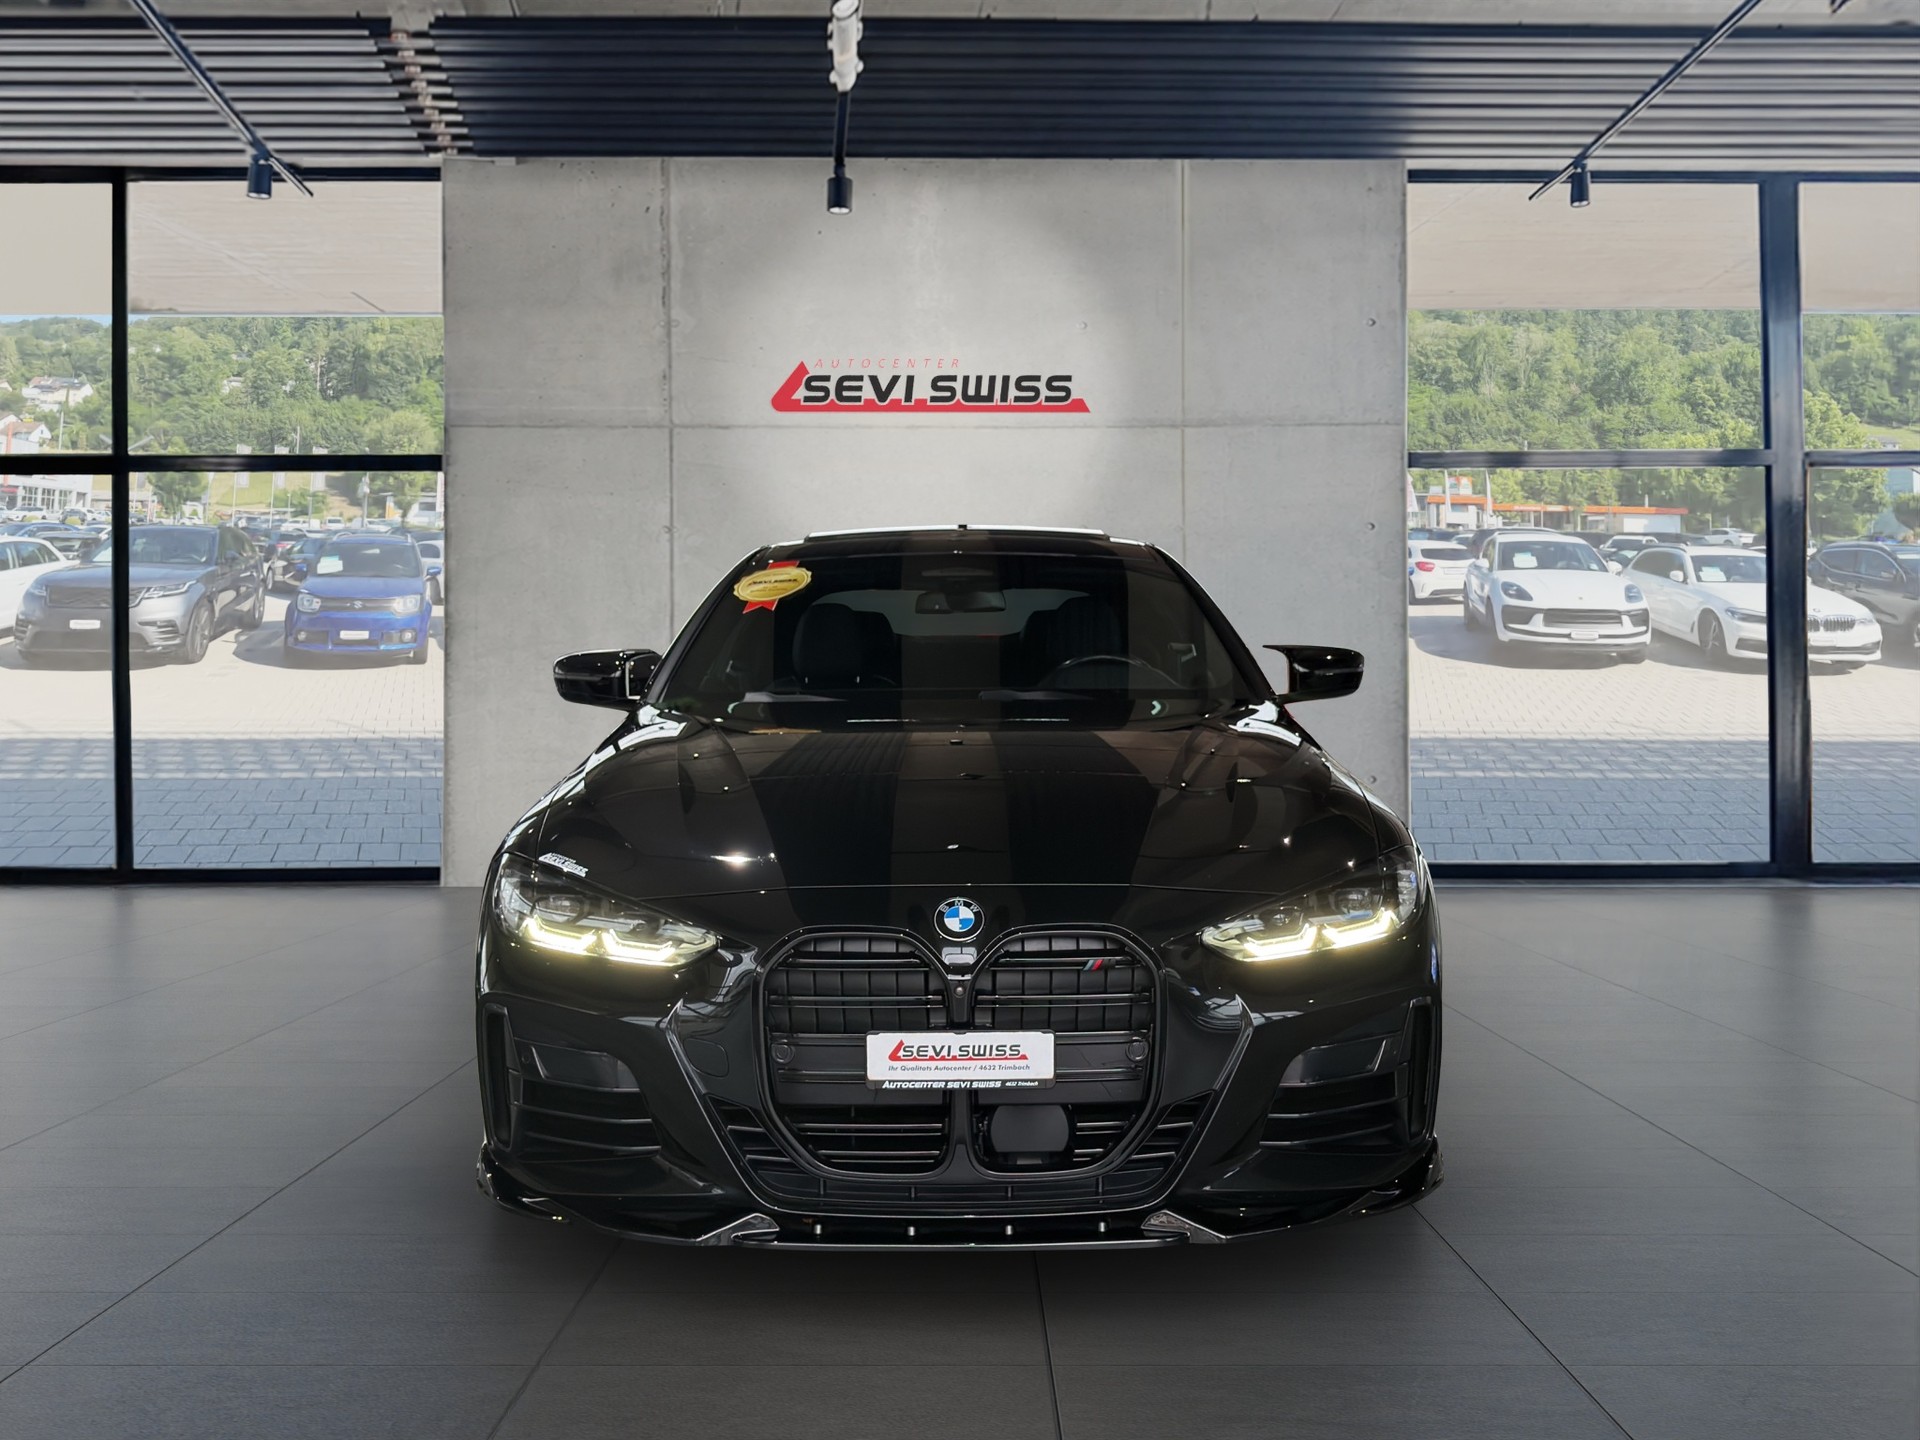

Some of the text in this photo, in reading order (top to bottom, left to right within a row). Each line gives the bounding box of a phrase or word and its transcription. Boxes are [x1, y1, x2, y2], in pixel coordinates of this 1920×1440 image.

[814, 358, 960, 369] AUTOCENTER
[802, 374, 1073, 403] SEVI SWISS
[902, 1044, 1021, 1057] SEVI SWISS
[947, 1081, 970, 1089] SEVI
